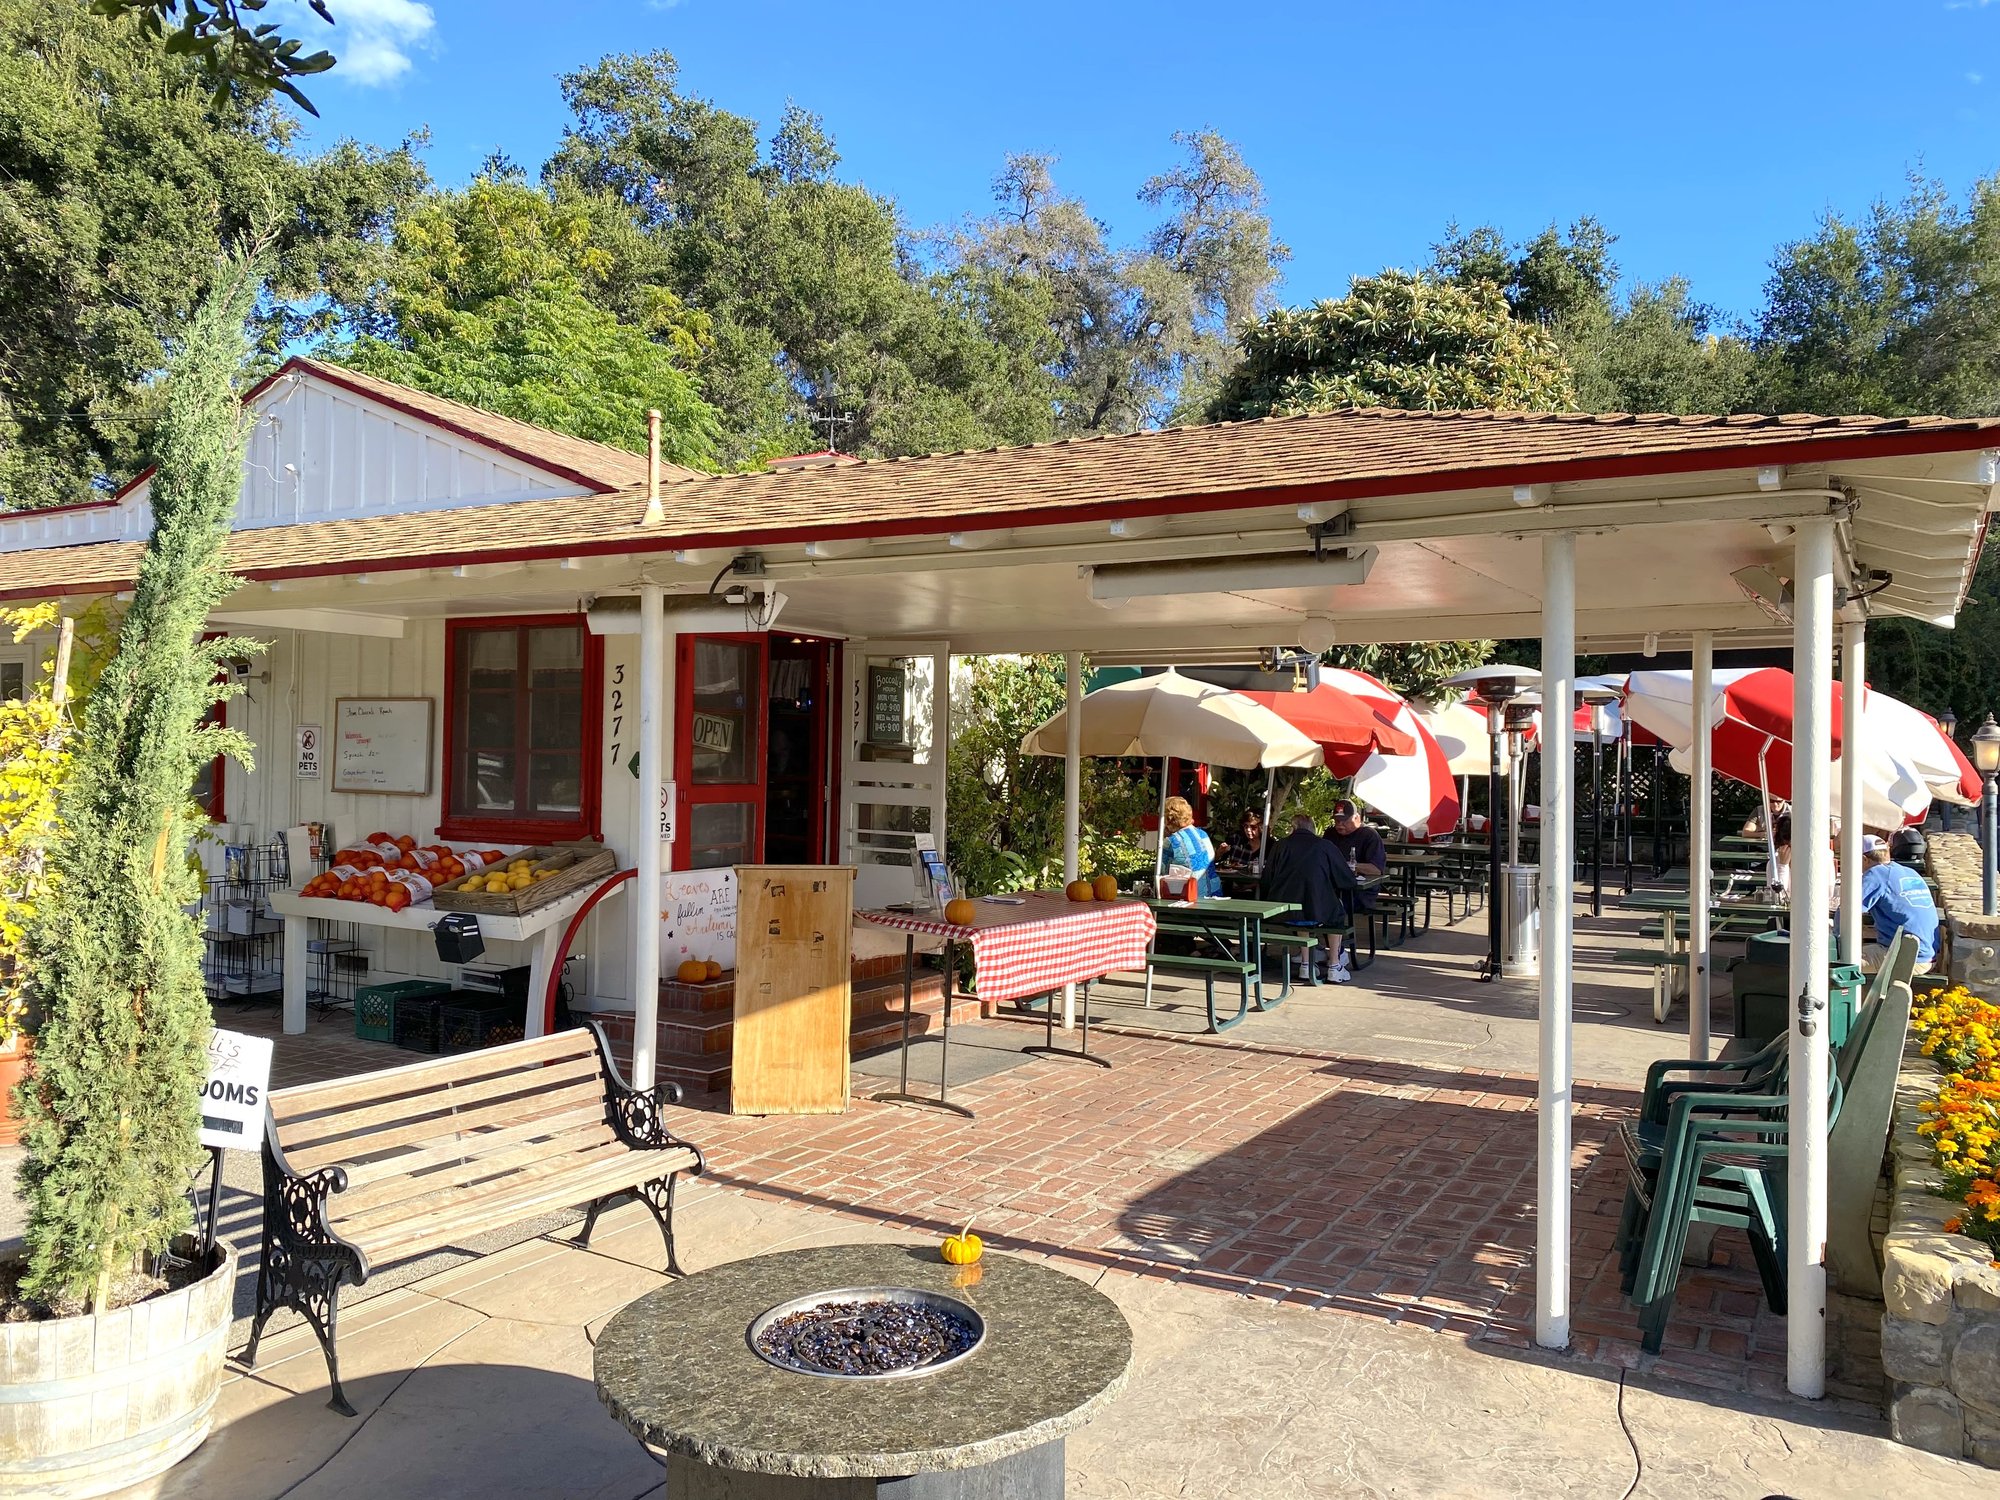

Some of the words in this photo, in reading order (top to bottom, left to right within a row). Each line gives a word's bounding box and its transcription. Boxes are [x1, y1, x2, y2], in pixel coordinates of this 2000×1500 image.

[610, 664, 625, 765] 3277
[693, 716, 731, 748] OPEN
[302, 752, 314, 760] NO
[298, 761, 318, 771] PETS
[660, 811, 667, 821] O
[660, 822, 671, 832] TS
[665, 878, 709, 900] Leaves
[709, 888, 730, 905] ARE
[685, 915, 734, 936] Autumn
[716, 932, 724, 941] IS
[208, 1031, 242, 1057] li's
[198, 1079, 259, 1106] OOMS
